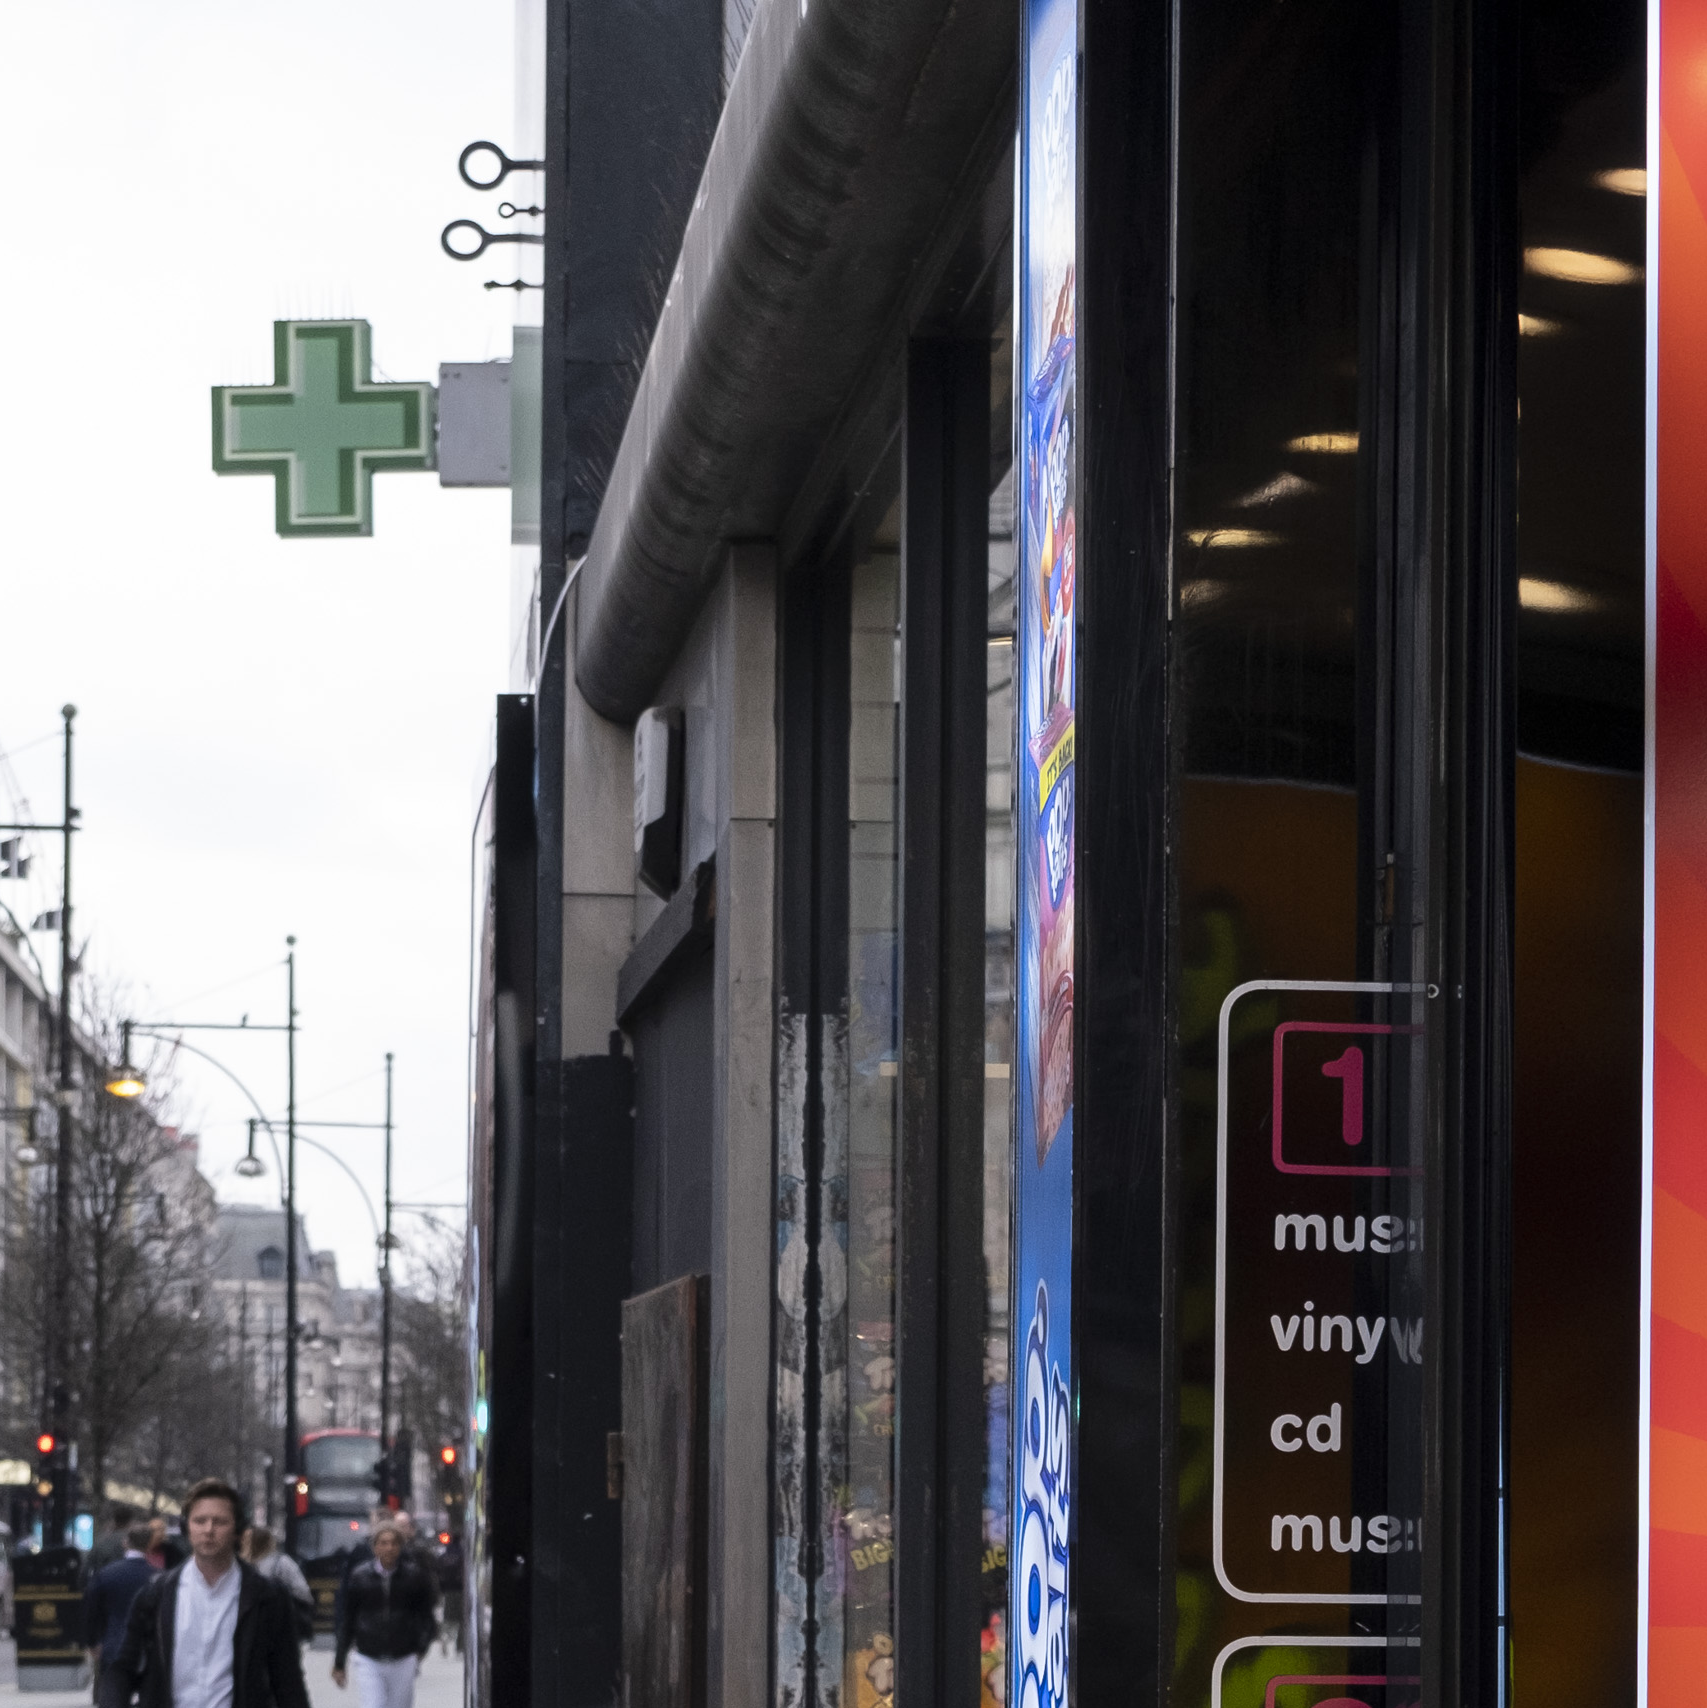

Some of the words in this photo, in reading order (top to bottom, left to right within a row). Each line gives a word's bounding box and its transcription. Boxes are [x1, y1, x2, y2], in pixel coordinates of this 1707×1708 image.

[1321, 1045, 1364, 1146] 1
[1270, 1402, 1342, 1453] cd
[850, 1540, 894, 1572] BIG
